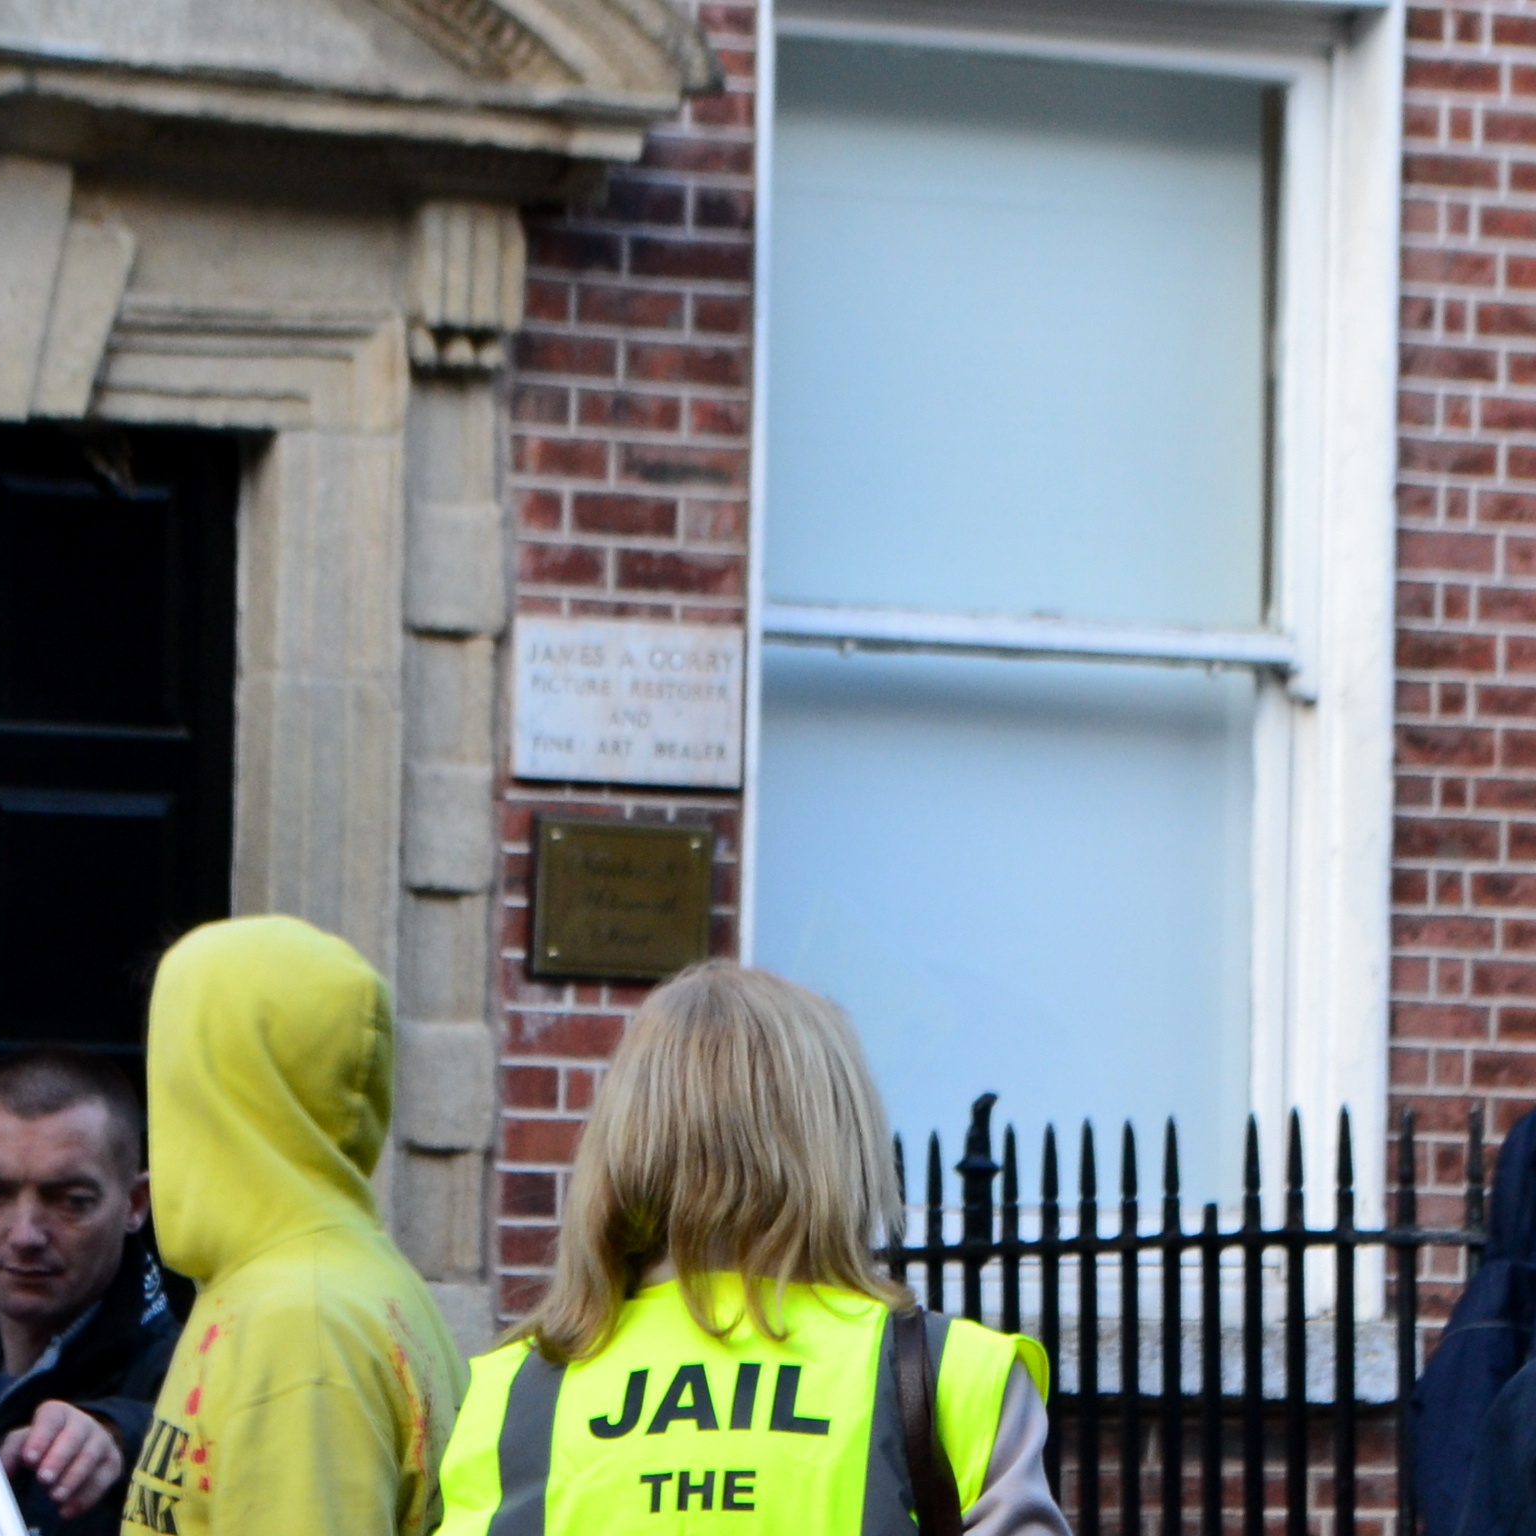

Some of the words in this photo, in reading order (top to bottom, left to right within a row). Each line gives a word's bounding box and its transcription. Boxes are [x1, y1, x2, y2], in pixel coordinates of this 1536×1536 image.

[527, 643, 605, 667] JAMES
[530, 674, 611, 697] PICTURE
[587, 1362, 833, 1440] JAIL
[639, 1469, 757, 1515] THE
